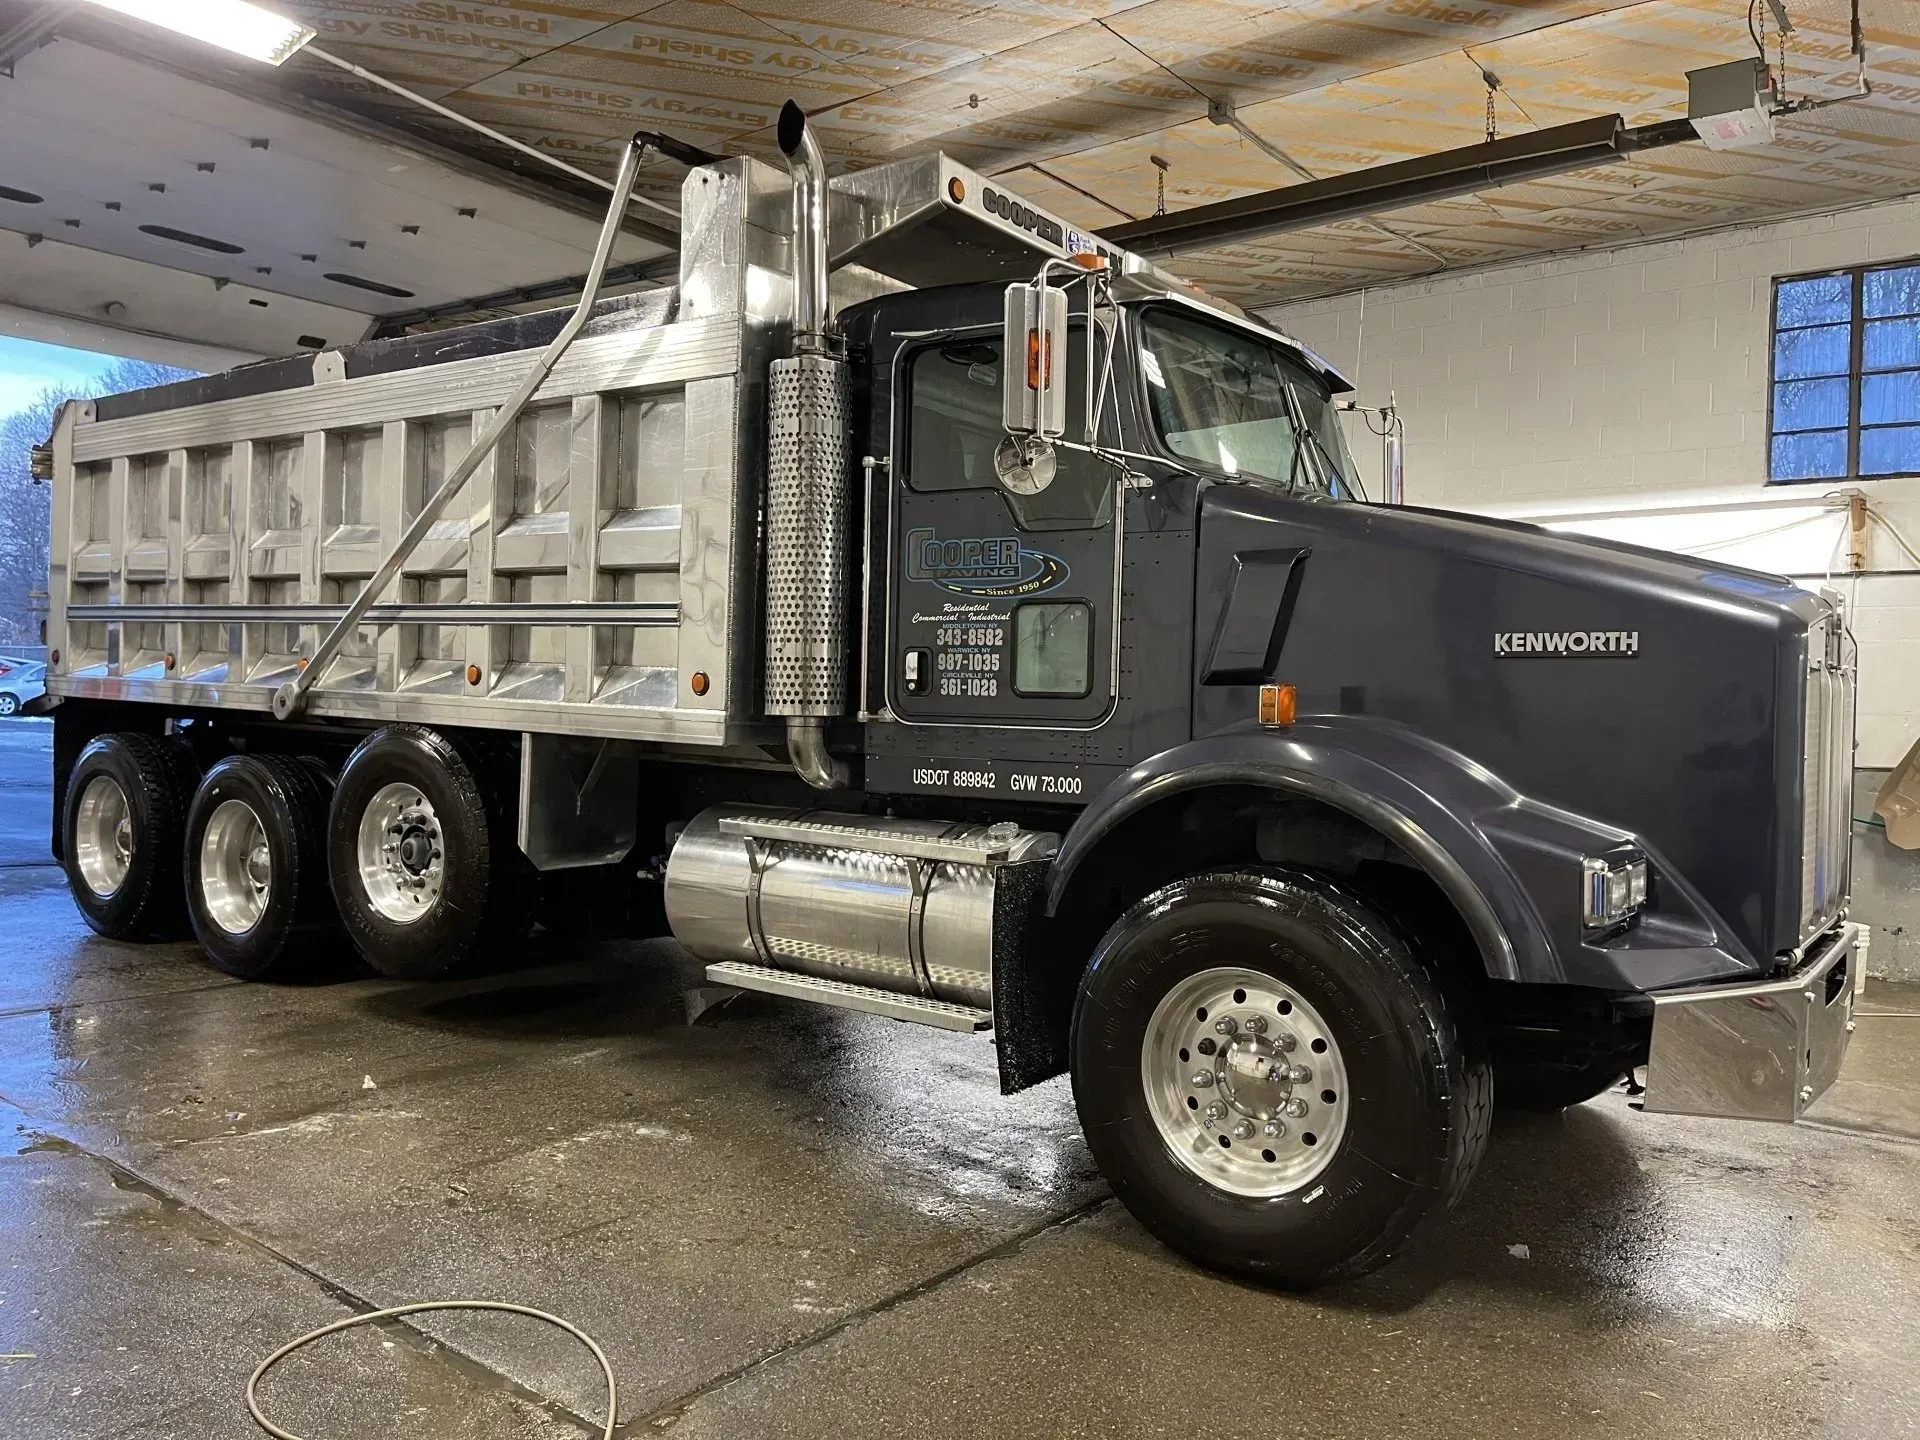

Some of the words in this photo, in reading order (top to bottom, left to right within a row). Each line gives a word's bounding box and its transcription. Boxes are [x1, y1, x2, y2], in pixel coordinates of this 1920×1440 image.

[634, 32, 757, 66] Shield
[516, 82, 633, 109] Shield
[639, 97, 768, 127] Energy
[983, 186, 1064, 249] COOPER
[905, 527, 1021, 582] COOPER
[936, 566, 1016, 578] PAVING
[986, 587, 1014, 596] Since
[1018, 581, 1040, 593] 1950
[912, 612, 958, 624] Commercial
[967, 611, 1011, 621] Industrial
[943, 603, 990, 613] Residential
[936, 628, 1003, 646] 343-8582
[1494, 631, 1639, 652] KENWORTH
[937, 653, 1000, 671] 987-1035
[940, 678, 998, 696] 361-1028
[913, 768, 949, 786] USDOT
[953, 770, 996, 789] 889842
[1010, 774, 1038, 792] GVW
[1041, 776, 1082, 794] 73.000
